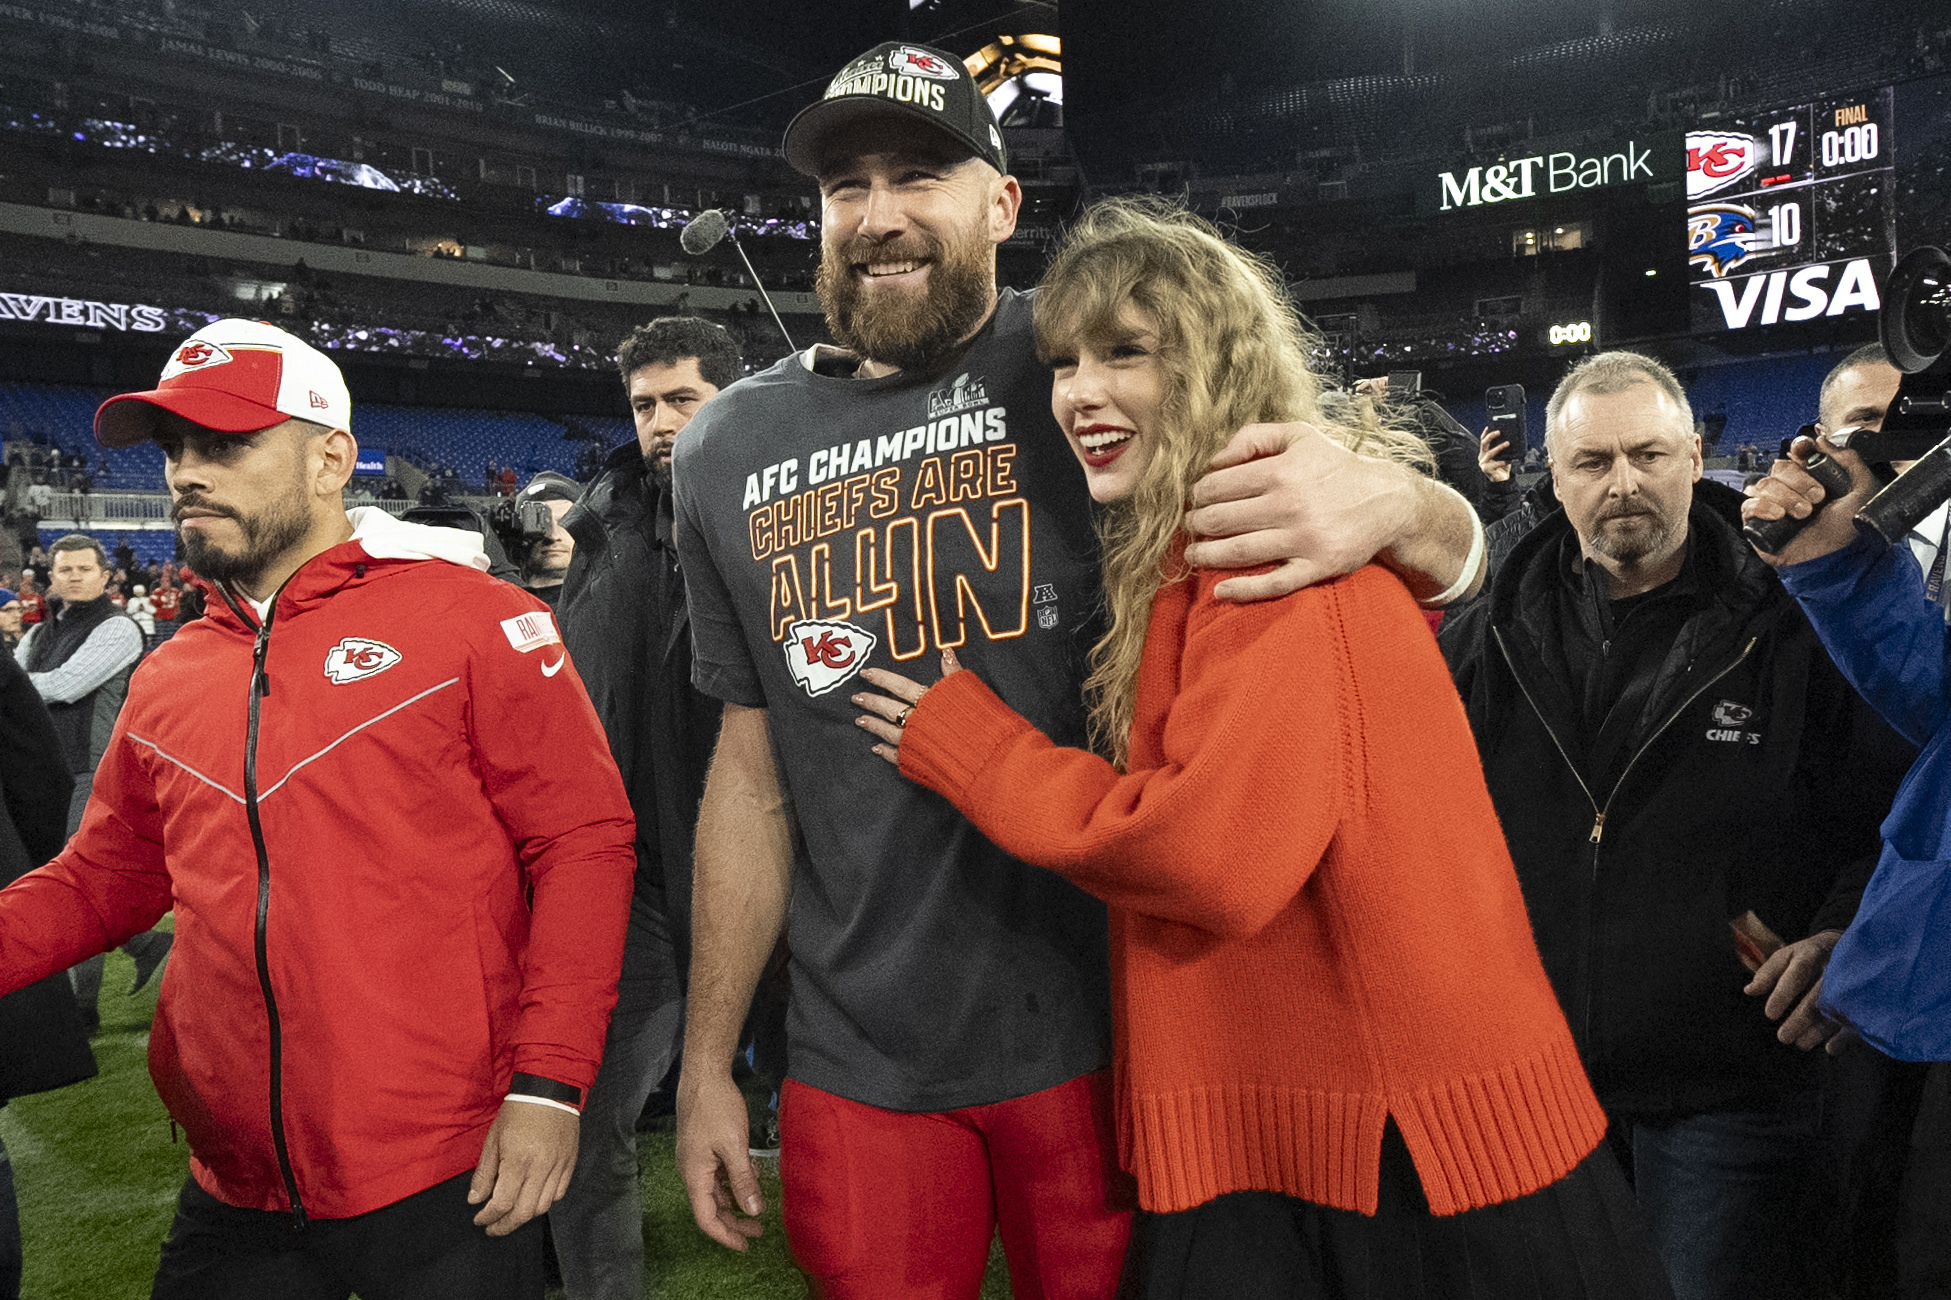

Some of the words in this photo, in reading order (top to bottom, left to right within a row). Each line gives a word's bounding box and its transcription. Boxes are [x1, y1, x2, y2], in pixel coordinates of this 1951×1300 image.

[351, 77, 386, 95] TODD
[388, 83, 421, 101] HEAP
[534, 114, 566, 128] BRIAN
[1835, 104, 1868, 127] FINAL
[703, 139, 738, 153] HALOTI
[1768, 120, 1797, 167] 17
[1821, 123, 1878, 167] 0:00
[1438, 155, 1543, 211] M&T
[1549, 140, 1653, 193] Bank
[1768, 202, 1800, 247] 10
[1700, 258, 1880, 329] VISA
[1549, 321, 1592, 345] 0:00
[743, 457, 798, 511] AFC
[808, 407, 1007, 486] CHAMPIONS
[749, 466, 900, 561] CHIEFS
[911, 443, 1018, 510] ARE
[770, 526, 899, 642] ALL
[885, 497, 1031, 661] IN
[1705, 728, 1761, 746] CHIES
